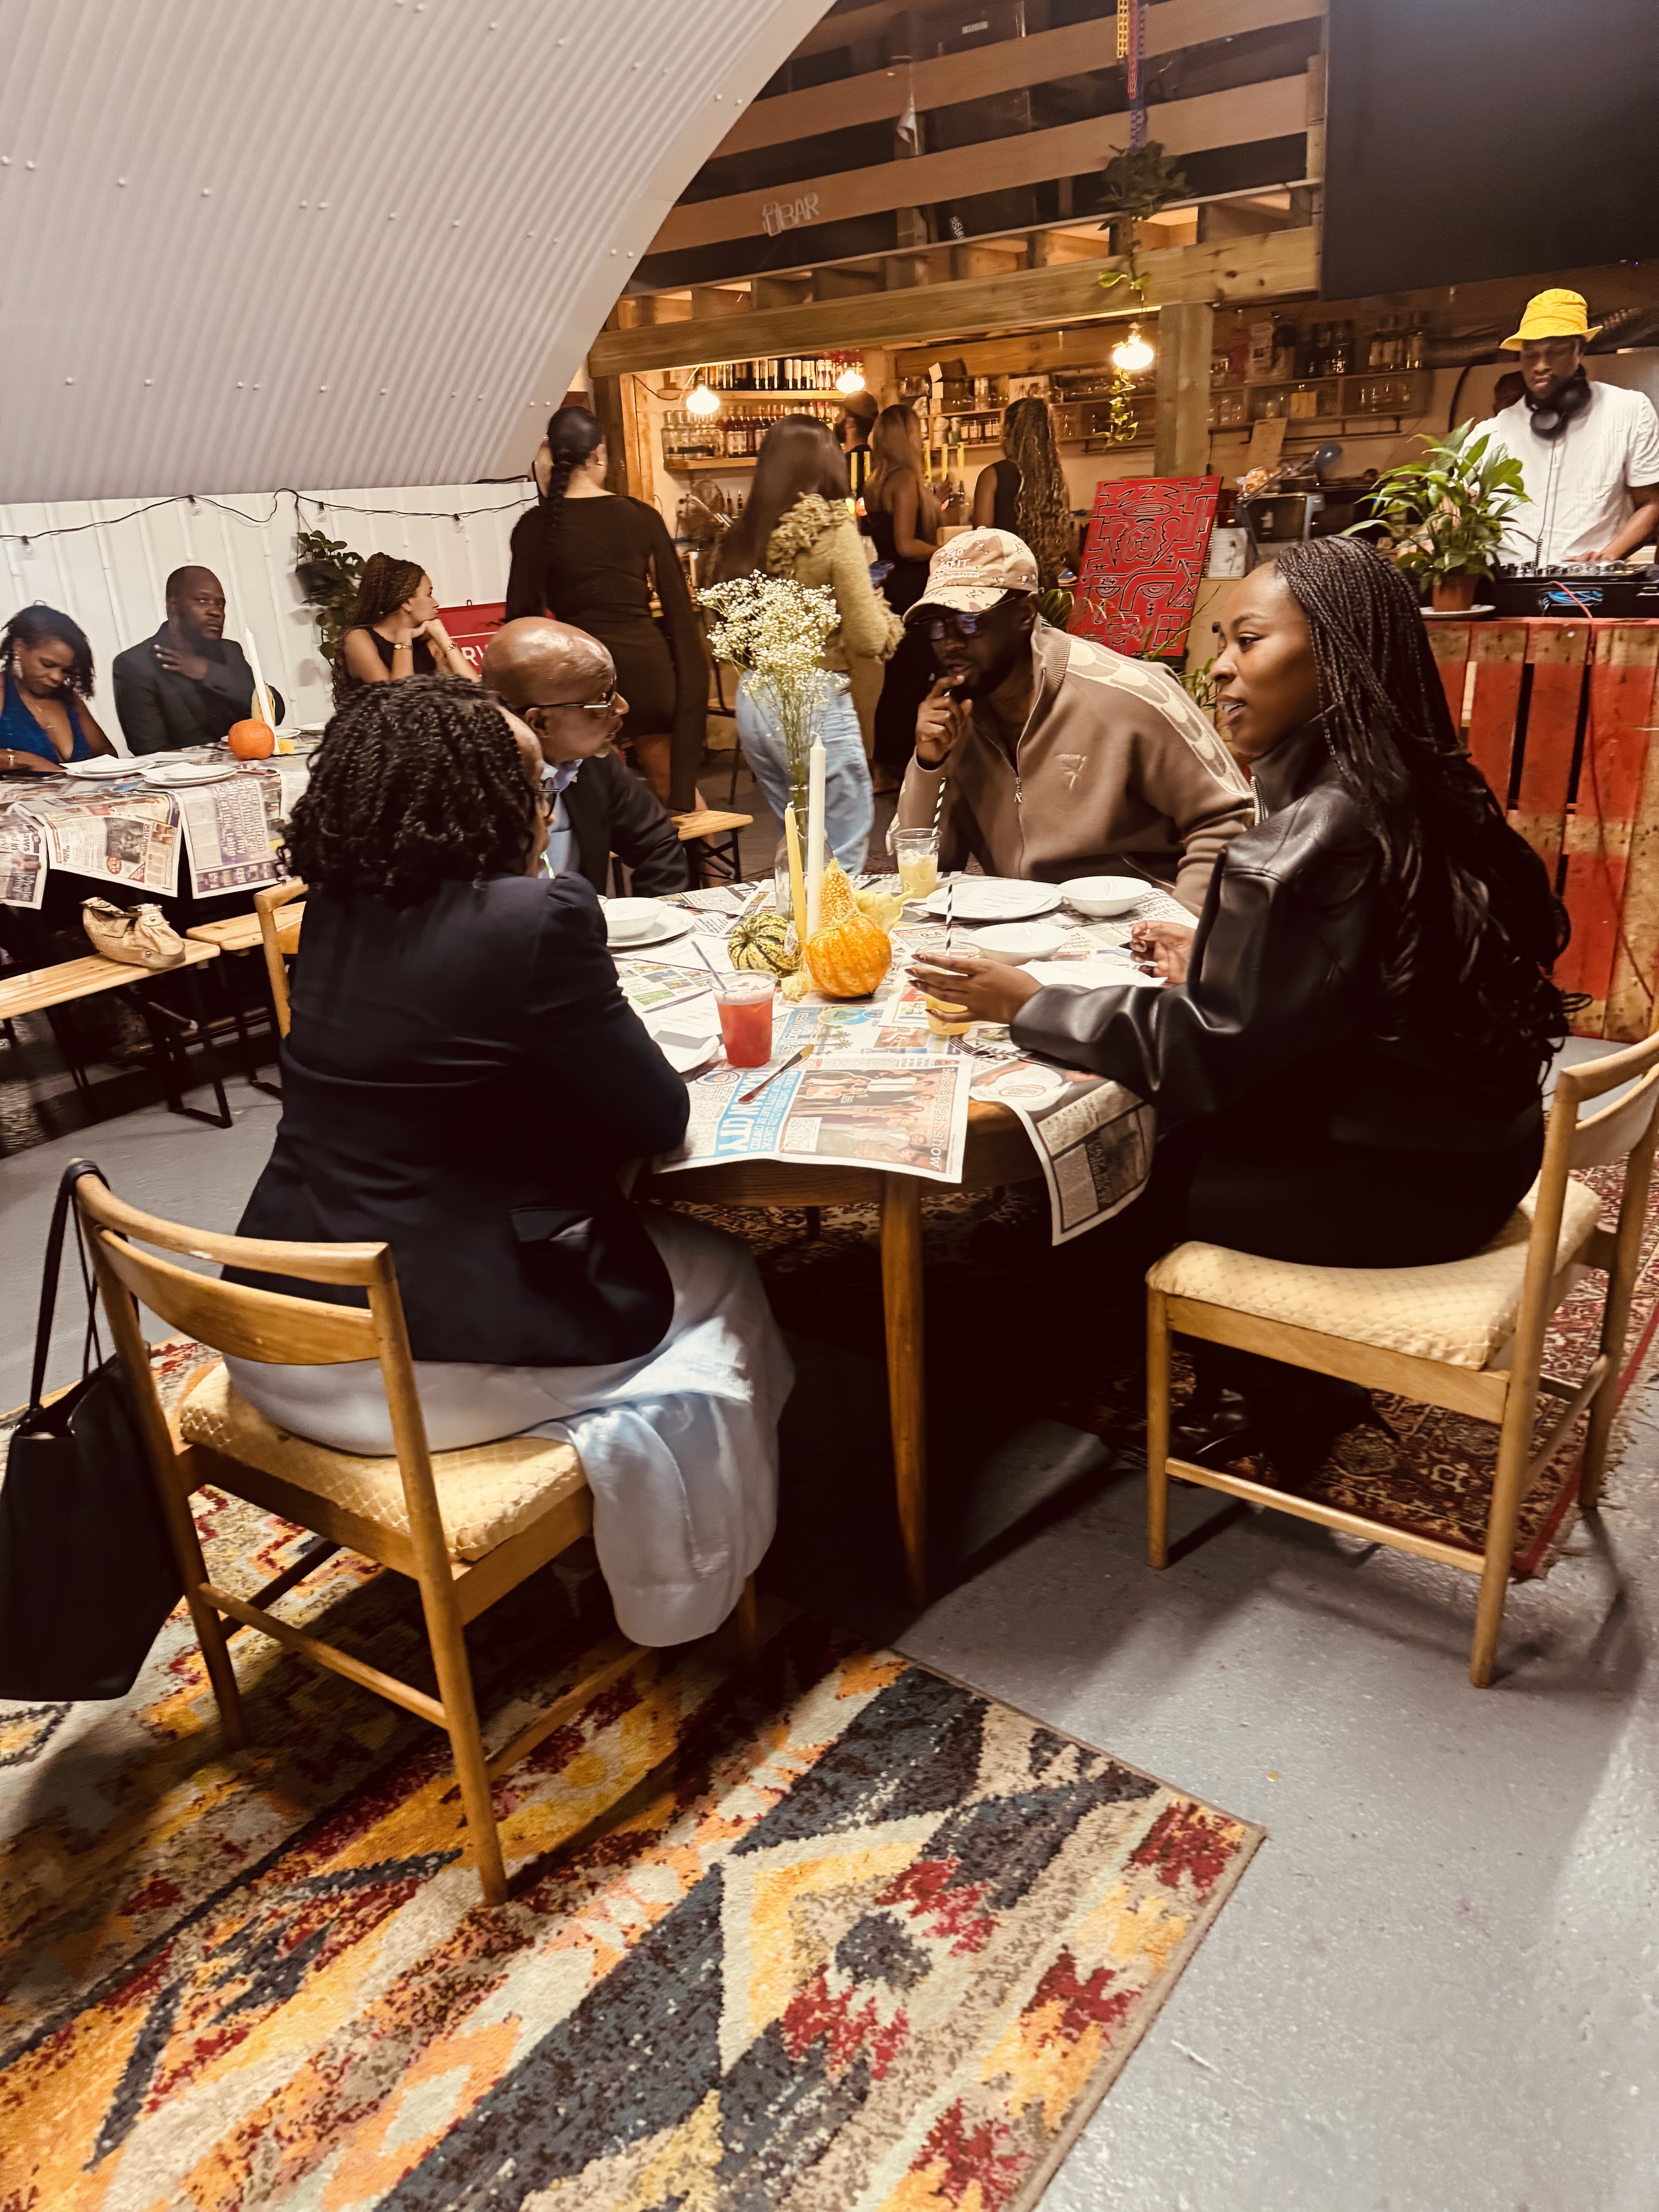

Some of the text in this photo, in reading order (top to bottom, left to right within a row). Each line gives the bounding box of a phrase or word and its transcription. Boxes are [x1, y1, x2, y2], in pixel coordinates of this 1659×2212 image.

[1139, 898, 1171, 908] work
[788, 1012, 812, 1027] really
[782, 1028, 805, 1040] dug
[934, 1104, 949, 1127] Posh
[718, 1117, 755, 1152] CITY
[750, 1125, 764, 1150] OWED
[930, 1130, 945, 1169] show
